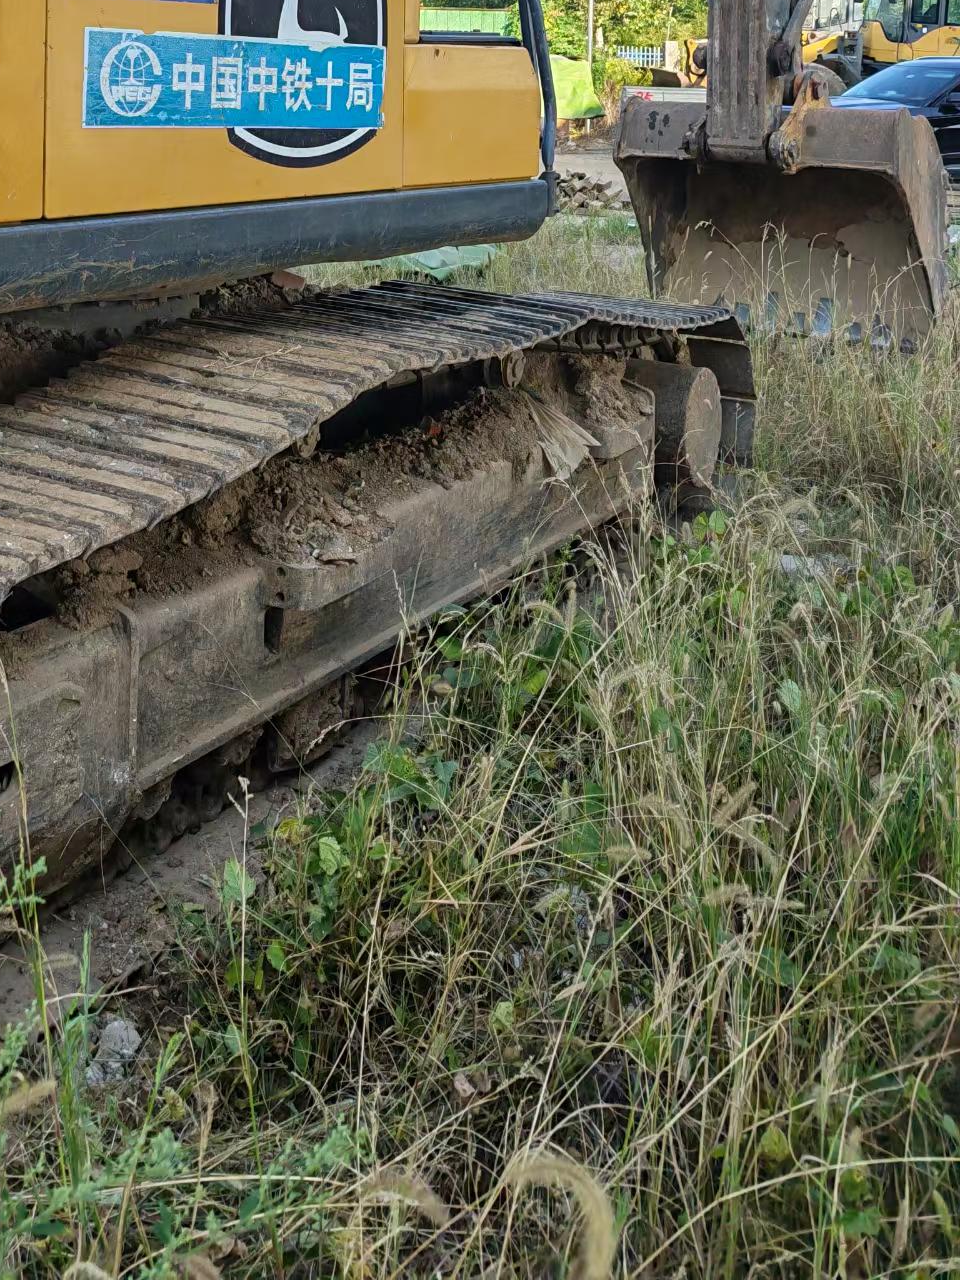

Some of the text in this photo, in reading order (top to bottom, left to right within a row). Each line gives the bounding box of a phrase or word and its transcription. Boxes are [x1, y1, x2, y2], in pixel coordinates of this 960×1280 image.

[171, 53, 374, 111] 中国中铁十局
